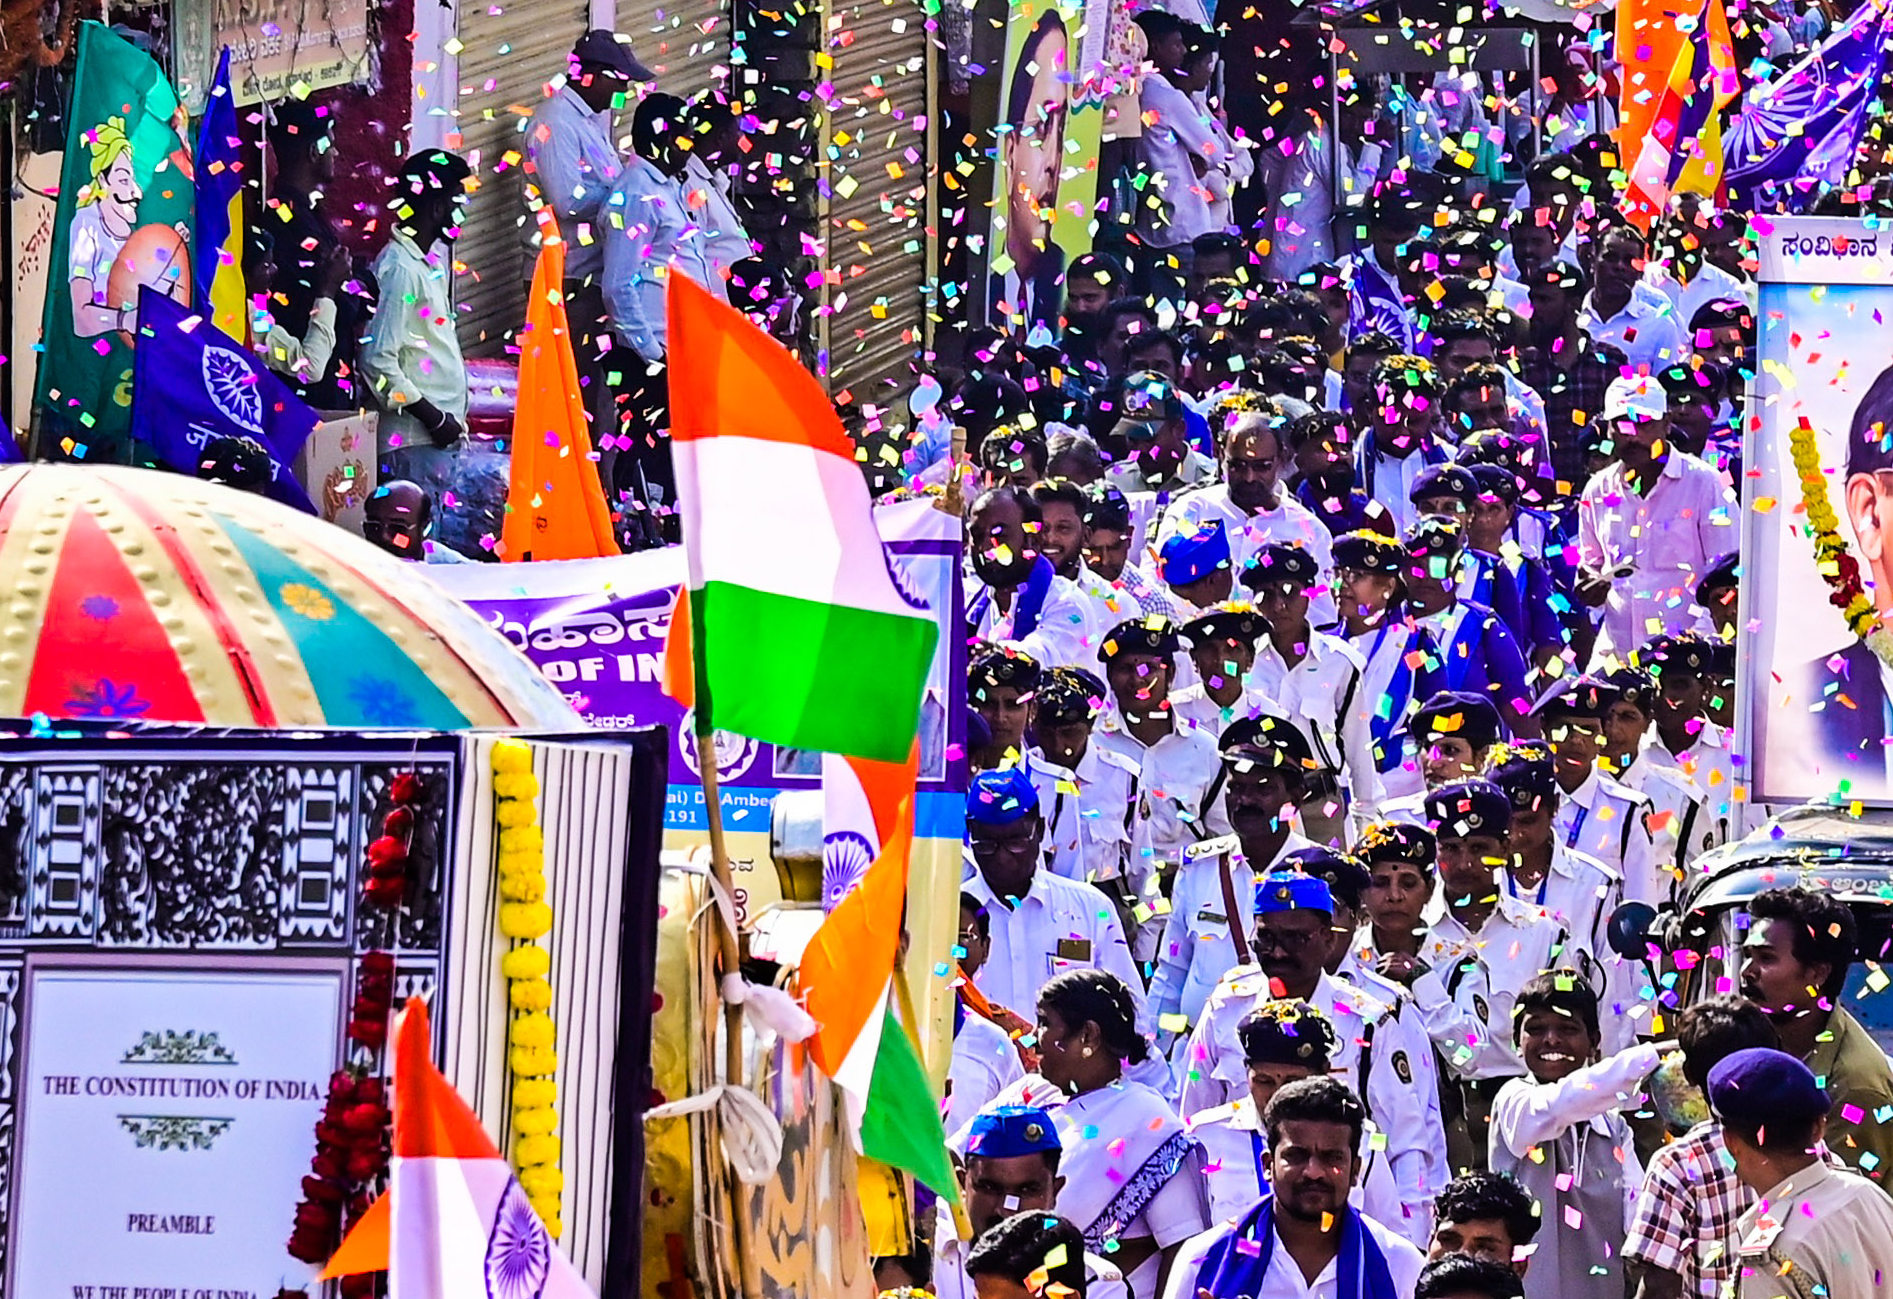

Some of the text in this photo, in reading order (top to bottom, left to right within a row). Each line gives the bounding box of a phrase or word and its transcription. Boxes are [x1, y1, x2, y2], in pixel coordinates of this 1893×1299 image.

[1782, 230, 1876, 259] ಸಂವಿಧಾನ
[541, 656, 605, 682] OF
[43, 1075, 320, 1101] THE CONSTITUTION OF INDIA
[127, 1213, 215, 1235] PREAMBLE
